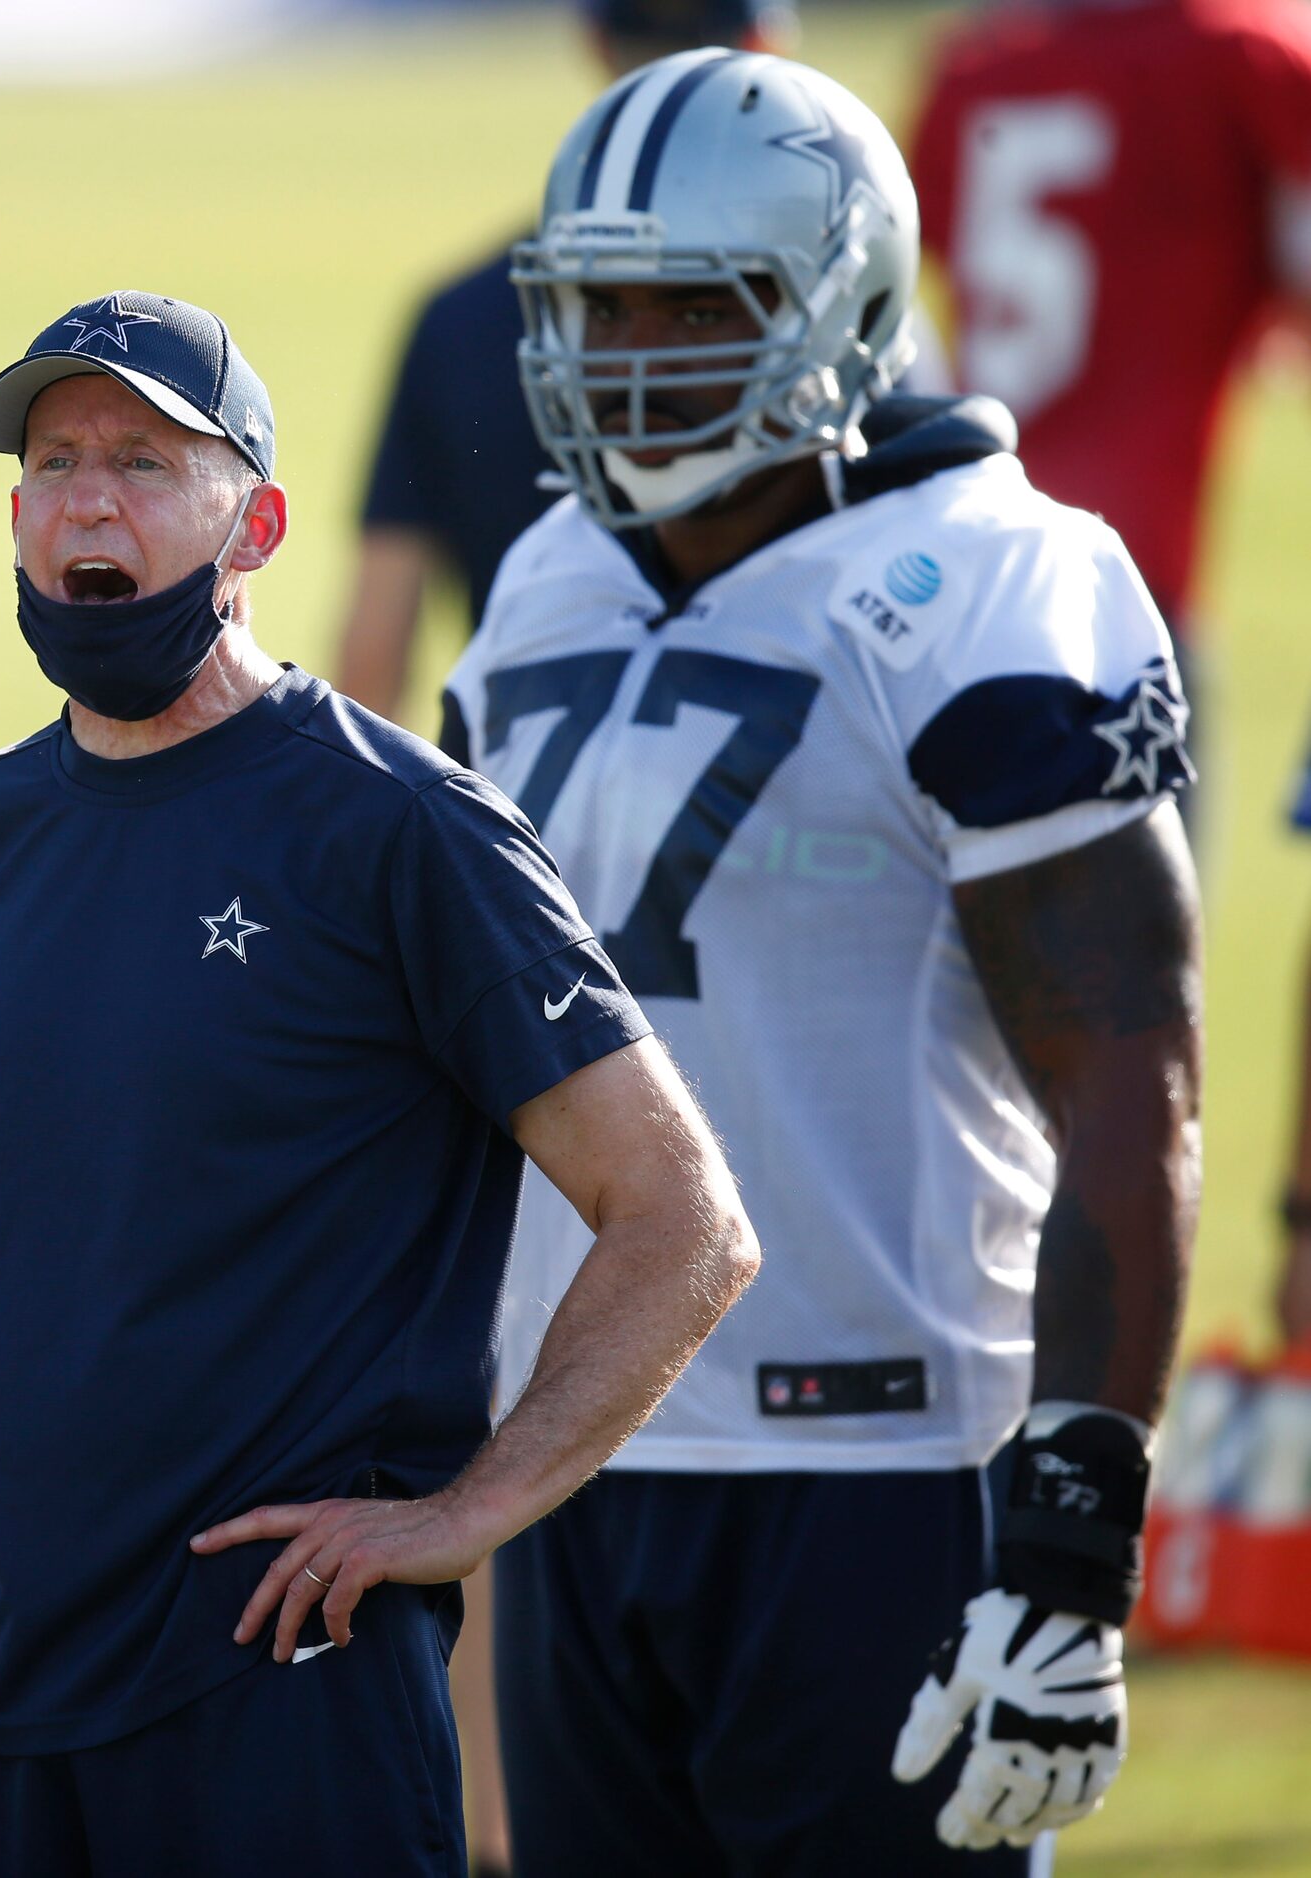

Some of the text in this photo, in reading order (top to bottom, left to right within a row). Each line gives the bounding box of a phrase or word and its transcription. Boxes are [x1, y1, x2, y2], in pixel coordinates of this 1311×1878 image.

[955, 96, 1117, 422] 5
[848, 590, 912, 642] AT&T
[483, 648, 822, 1001] 77
